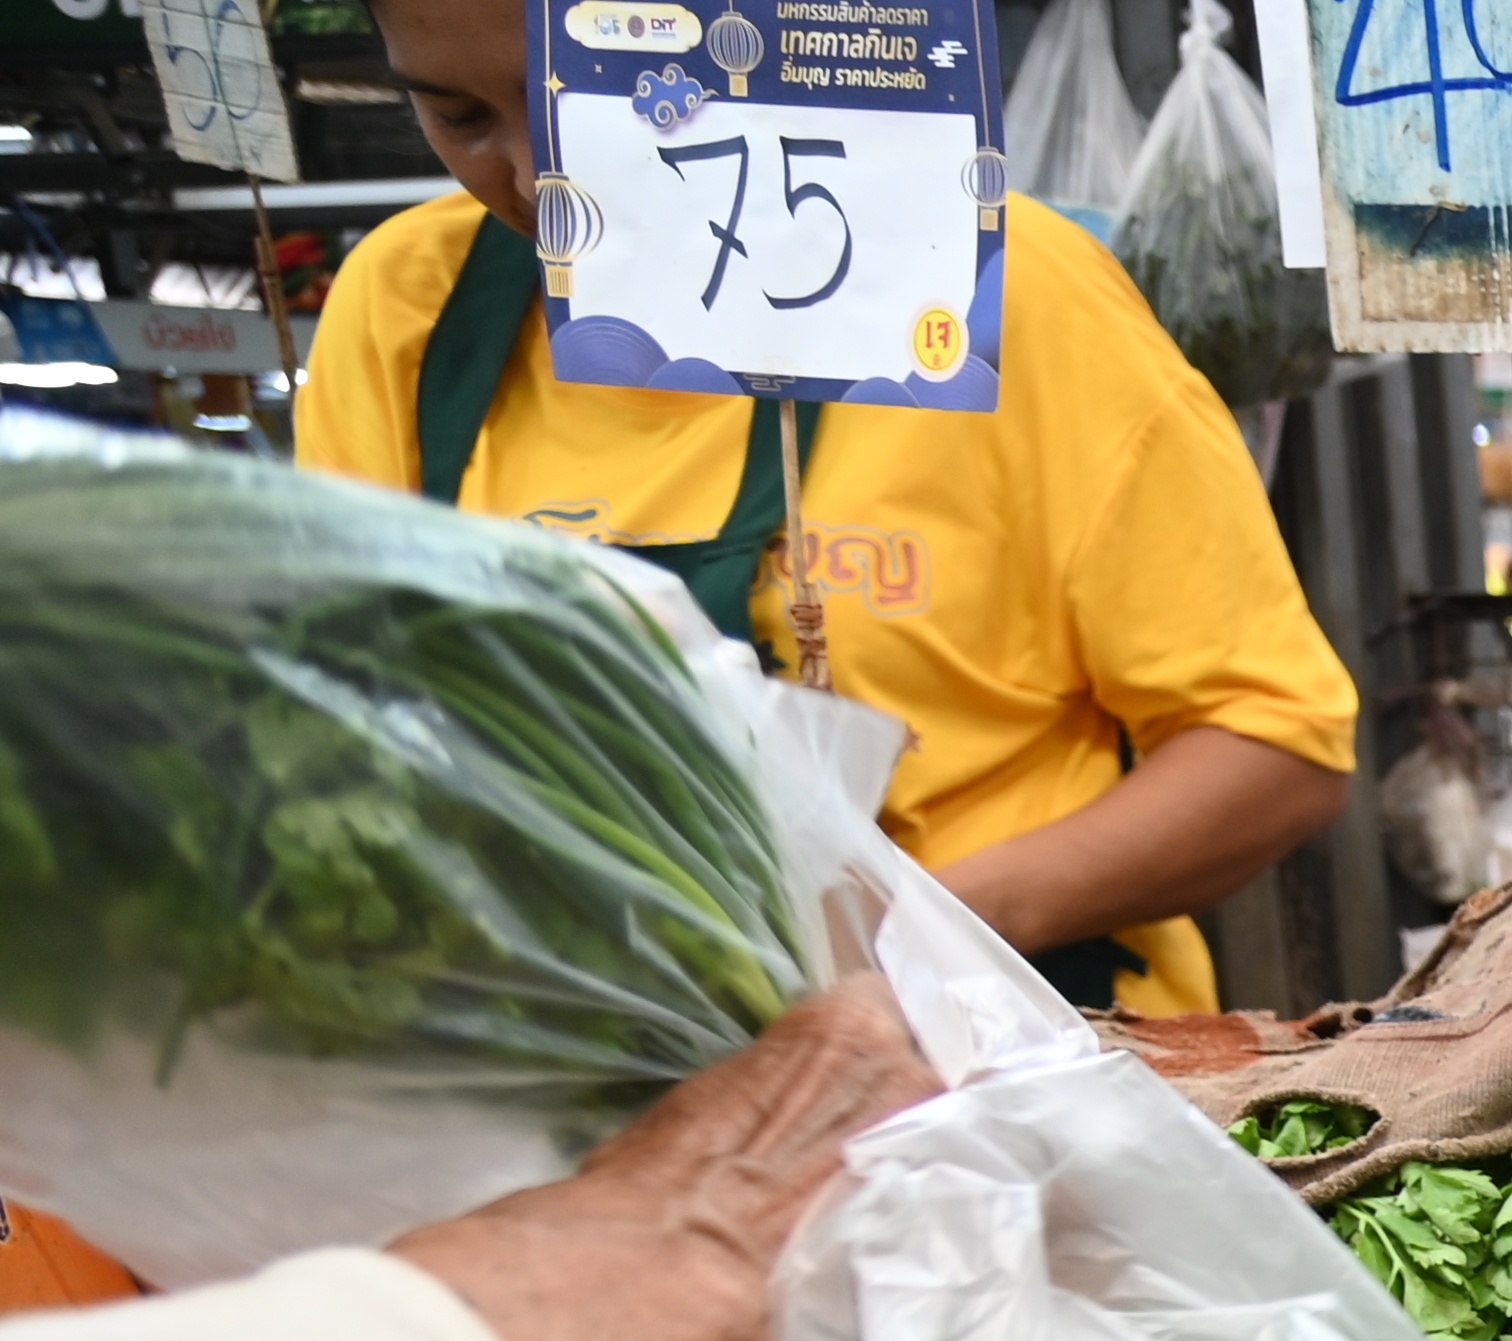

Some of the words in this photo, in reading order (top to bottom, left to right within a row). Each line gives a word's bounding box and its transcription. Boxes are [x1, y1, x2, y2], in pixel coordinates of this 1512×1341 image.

[777, 0, 929, 27] มหกรรมสินค้าลดราคา
[780, 28, 918, 61] เทศกาลกินเจ
[780, 56, 830, 87] อิ่มบุญ
[834, 66, 927, 91] ราคาประหยัด
[657, 135, 852, 311] 75
